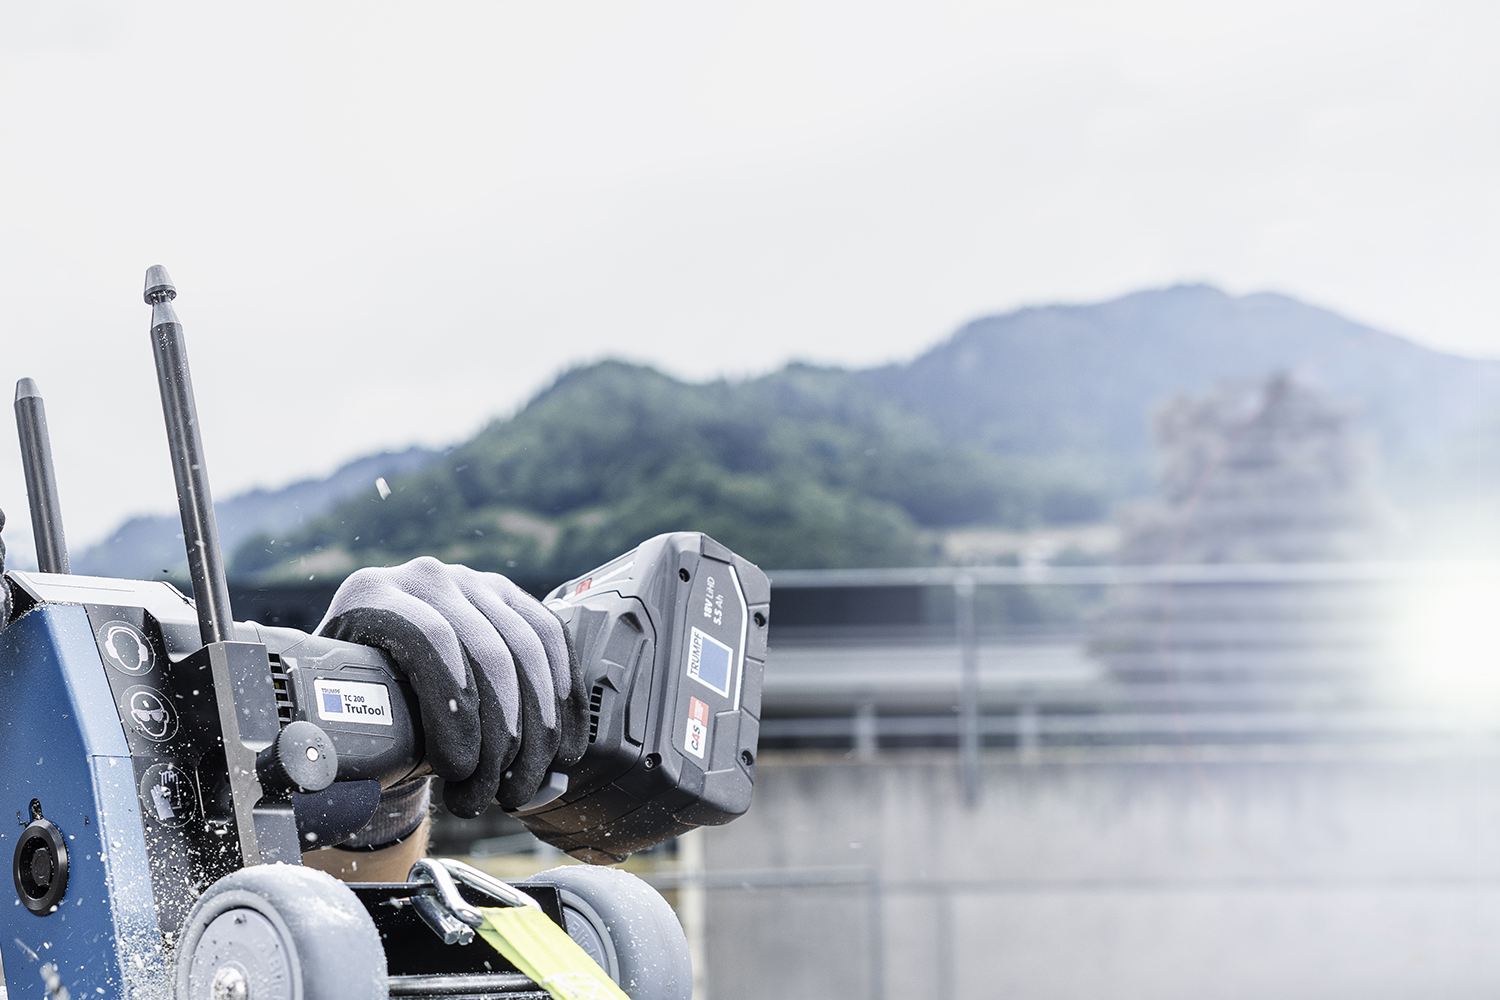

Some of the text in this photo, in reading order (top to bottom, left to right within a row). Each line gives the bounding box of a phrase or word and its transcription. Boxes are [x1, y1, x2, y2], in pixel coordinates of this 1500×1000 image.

[703, 576, 715, 618] 18V LiHD
[713, 594, 724, 626] 5.5 Ah
[690, 631, 702, 676] TRUMPF
[344, 694, 365, 704] TC 200
[345, 703, 385, 716] TruTool
[691, 724, 701, 751] CAS
